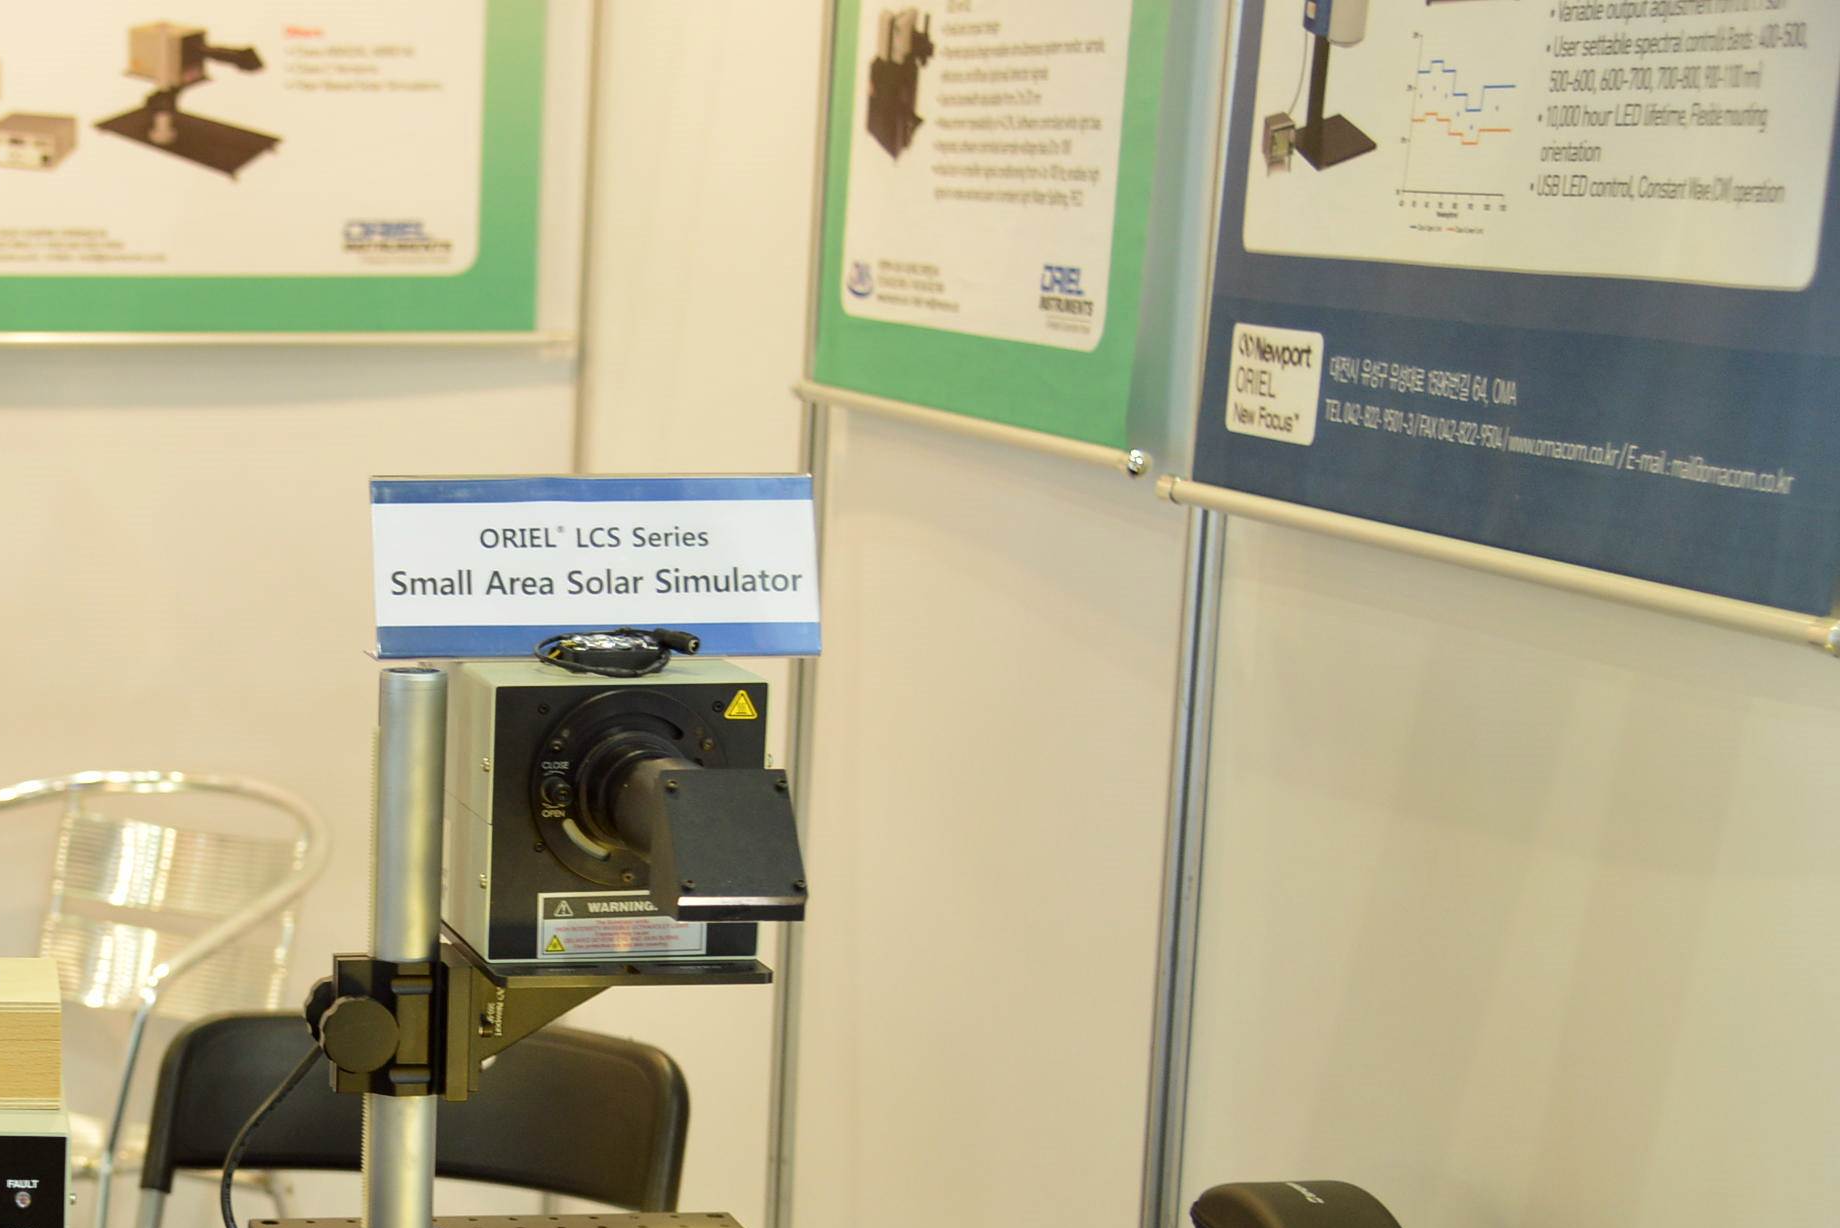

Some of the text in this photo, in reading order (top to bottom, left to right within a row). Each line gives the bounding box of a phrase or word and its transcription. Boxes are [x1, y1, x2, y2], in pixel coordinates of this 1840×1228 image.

[1553, 35, 1581, 57] User
[1582, 36, 1632, 56] settable
[1635, 30, 1682, 59] spectral
[1549, 70, 1596, 94] 500-600,
[1600, 67, 1653, 92] 600-700,
[1657, 66, 1702, 91] 700-800,
[1547, 105, 1580, 129] 10,000
[1582, 106, 1613, 127] hour
[1614, 103, 1642, 127] LED
[1540, 140, 1602, 162] orientation
[1536, 175, 1560, 197] USB
[1561, 175, 1588, 197] LED
[1590, 176, 1635, 200] control,
[1638, 175, 1687, 200] Constant
[1256, 337, 1313, 370] Newport
[1235, 367, 1276, 398] ORIEL
[1330, 356, 1359, 384] 대전시
[1361, 358, 1388, 389] 유성구
[1492, 378, 1518, 406] OMA
[1234, 402, 1256, 425] New
[1326, 397, 1342, 423] TEL
[577, 527, 621, 548] LCS
[632, 525, 709, 548] Series
[391, 567, 803, 596] Small Area Solar Simulator
[541, 760, 570, 770] CLOSE
[541, 809, 567, 819] OPEN
[7, 1180, 39, 1189] FAULT
